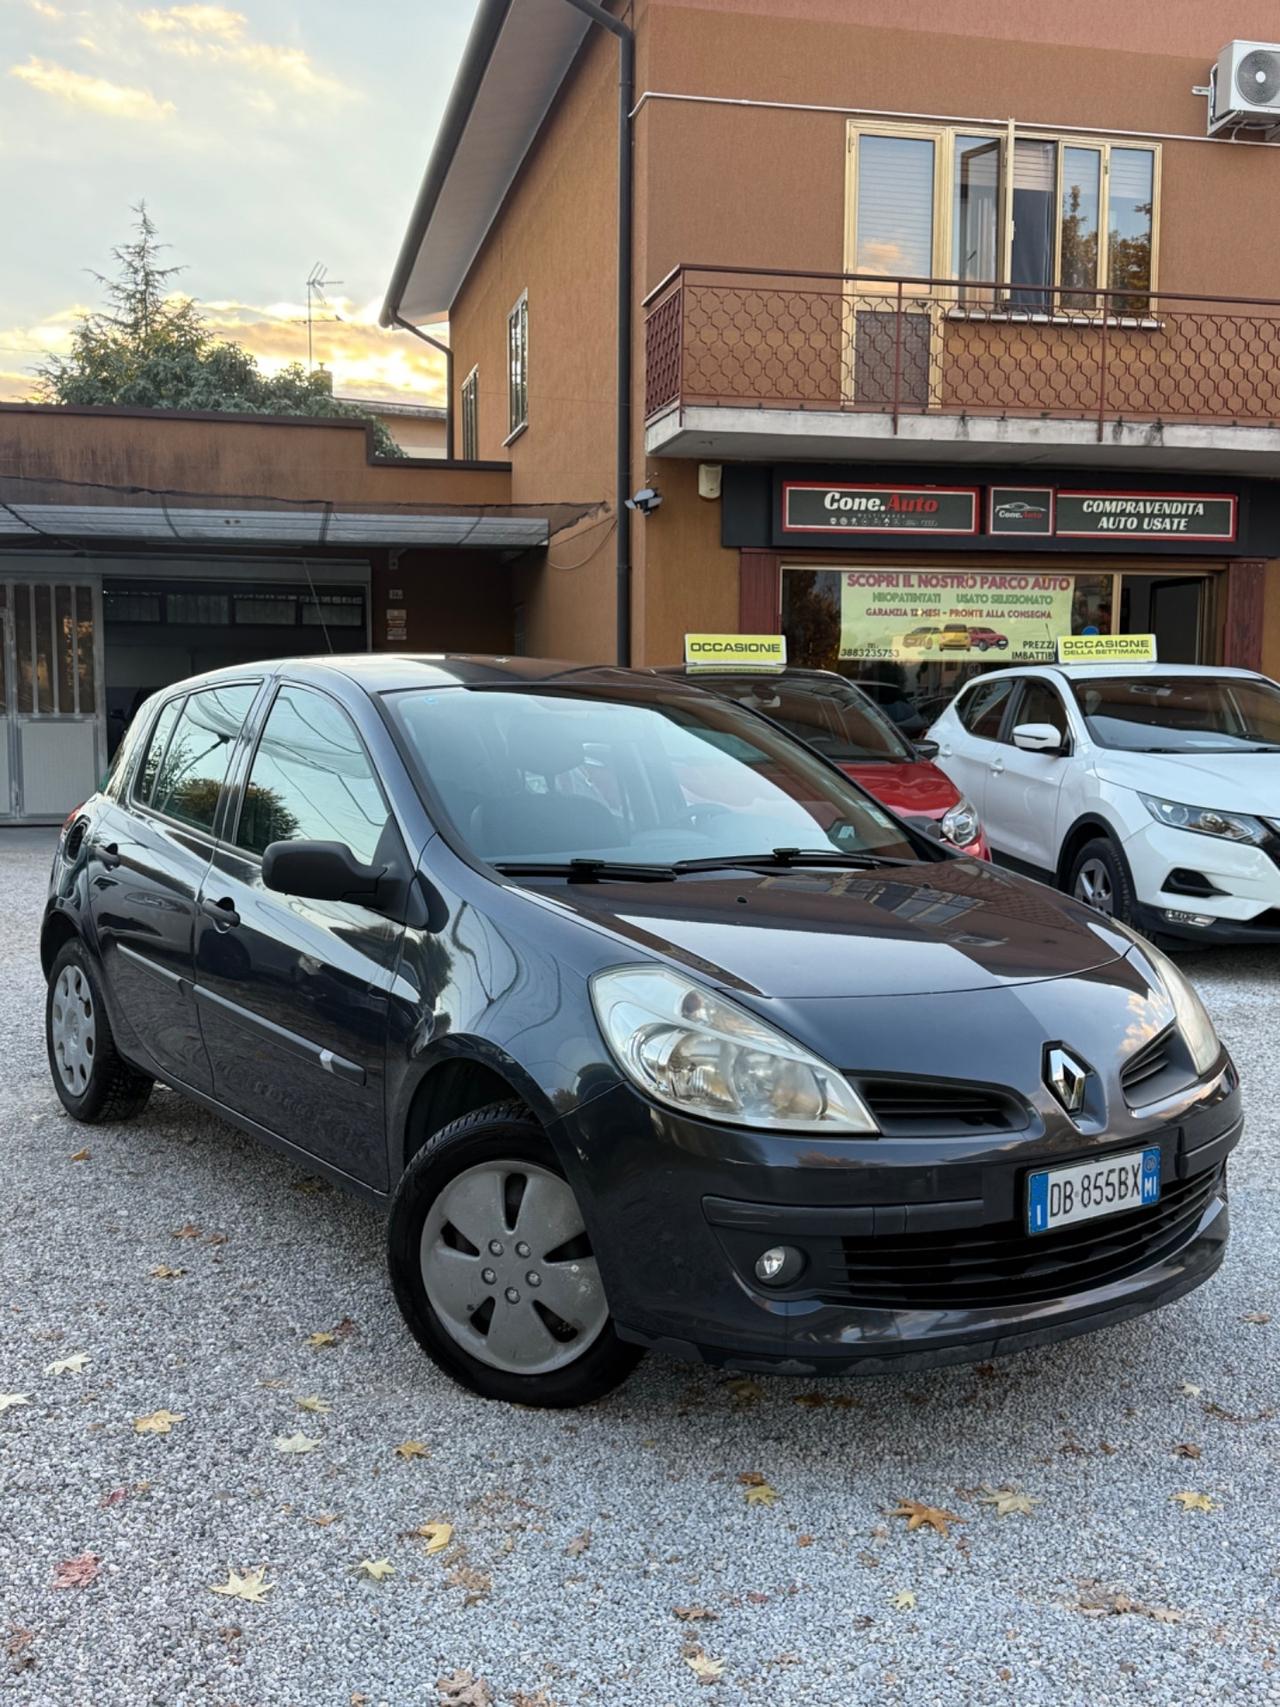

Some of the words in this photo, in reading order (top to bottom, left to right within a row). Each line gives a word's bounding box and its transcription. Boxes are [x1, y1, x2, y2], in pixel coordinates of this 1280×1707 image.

[824, 491, 939, 512] Cone.Auto
[1082, 499, 1204, 515] COMPRAVENDITA
[1097, 516, 1138, 530] AUTO
[1143, 517, 1189, 531] USATE
[847, 573, 900, 588] SCOPRI
[902, 574, 915, 588] IL
[917, 575, 977, 589] NOSTRO
[979, 575, 1029, 590] PARCO
[1030, 576, 1071, 591] AUTO
[956, 593, 989, 604] USATO
[990, 594, 1054, 605] SELEZIONATO
[865, 607, 908, 617] GARANZIA
[910, 608, 918, 617] 12
[920, 608, 941, 617] MESI
[948, 608, 983, 618] PRONTE
[985, 609, 1005, 618] ALLA
[1007, 609, 1052, 619] CONSEGNA
[690, 642, 781, 653] OCCASIONE
[1022, 640, 1055, 649] PREZZI
[1063, 639, 1149, 649] OCCASIONE
[840, 649, 900, 658] 3883235753
[1011, 651, 1055, 660] IMBATTIB
[1144, 1176, 1157, 1198] MI
[1036, 1204, 1041, 1226] I
